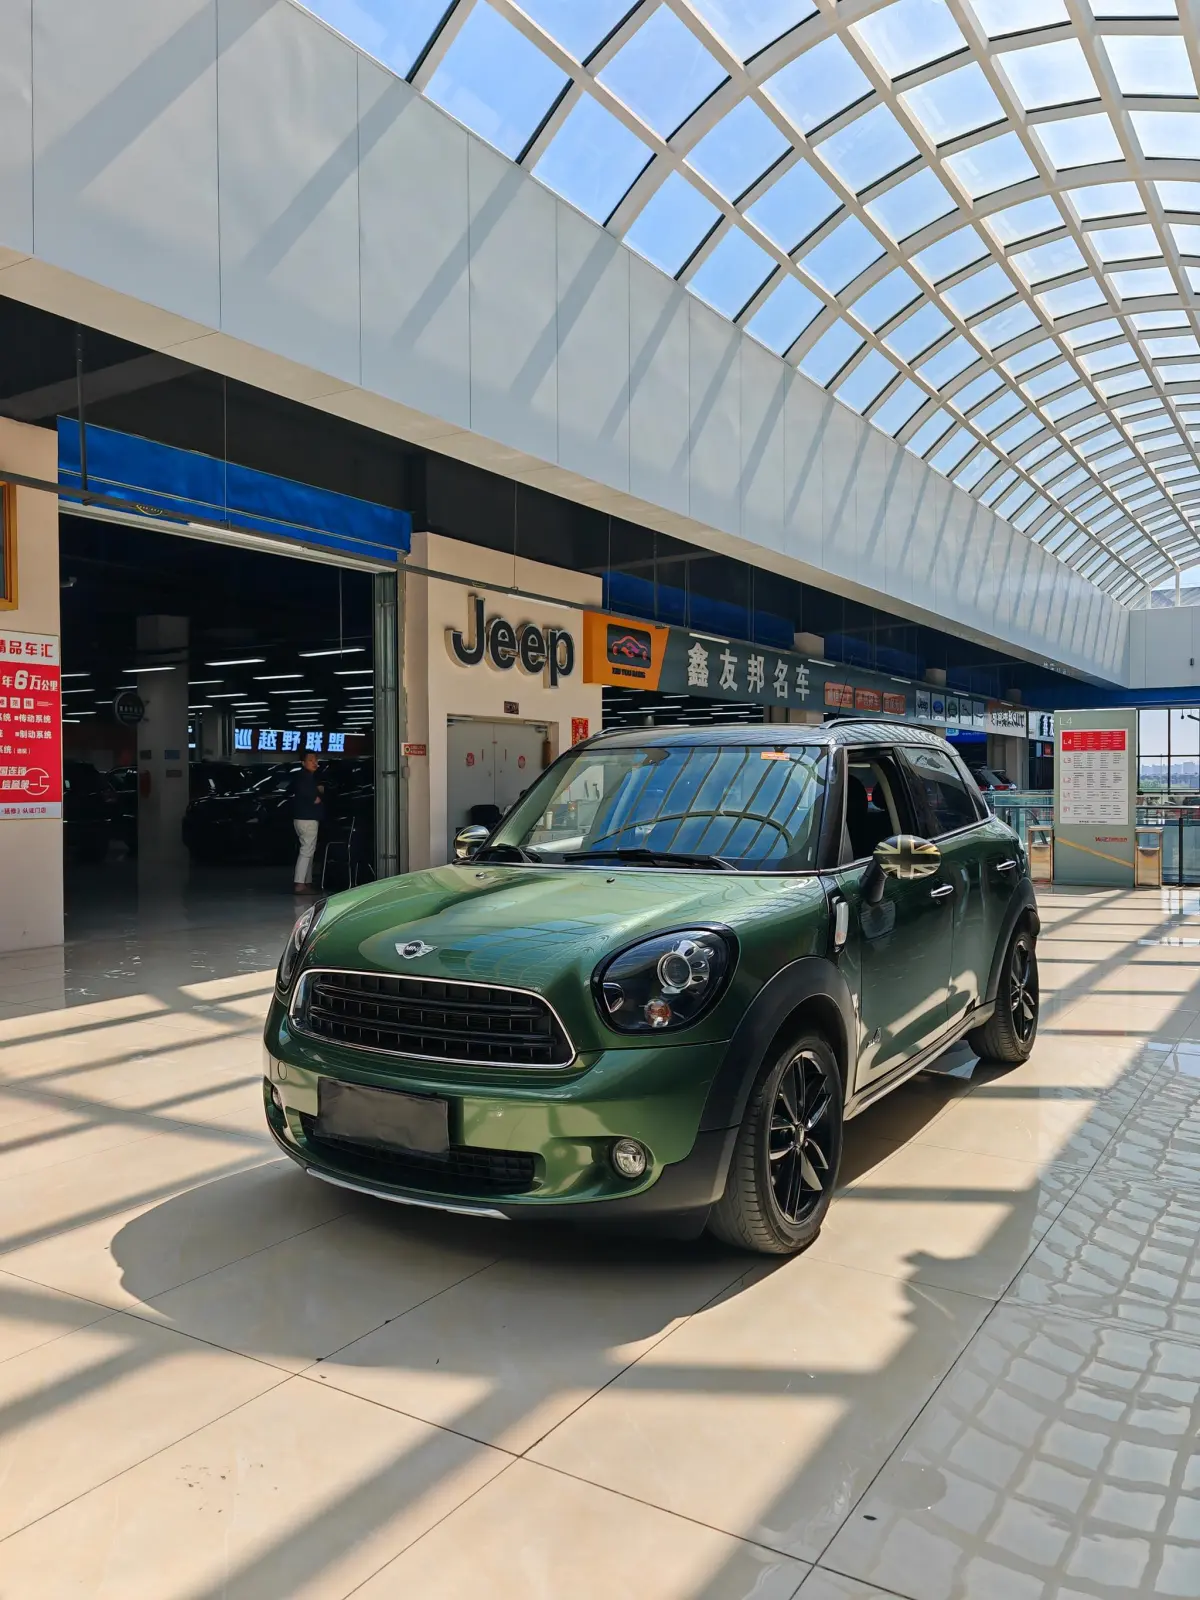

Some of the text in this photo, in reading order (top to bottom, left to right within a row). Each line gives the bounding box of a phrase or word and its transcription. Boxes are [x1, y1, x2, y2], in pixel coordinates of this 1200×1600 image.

[446, 595, 575, 688] Jeep
[2, 669, 58, 691] 年6万公里
[687, 642, 810, 701] 鑫友邦名车
[1060, 716, 1072, 726] L4
